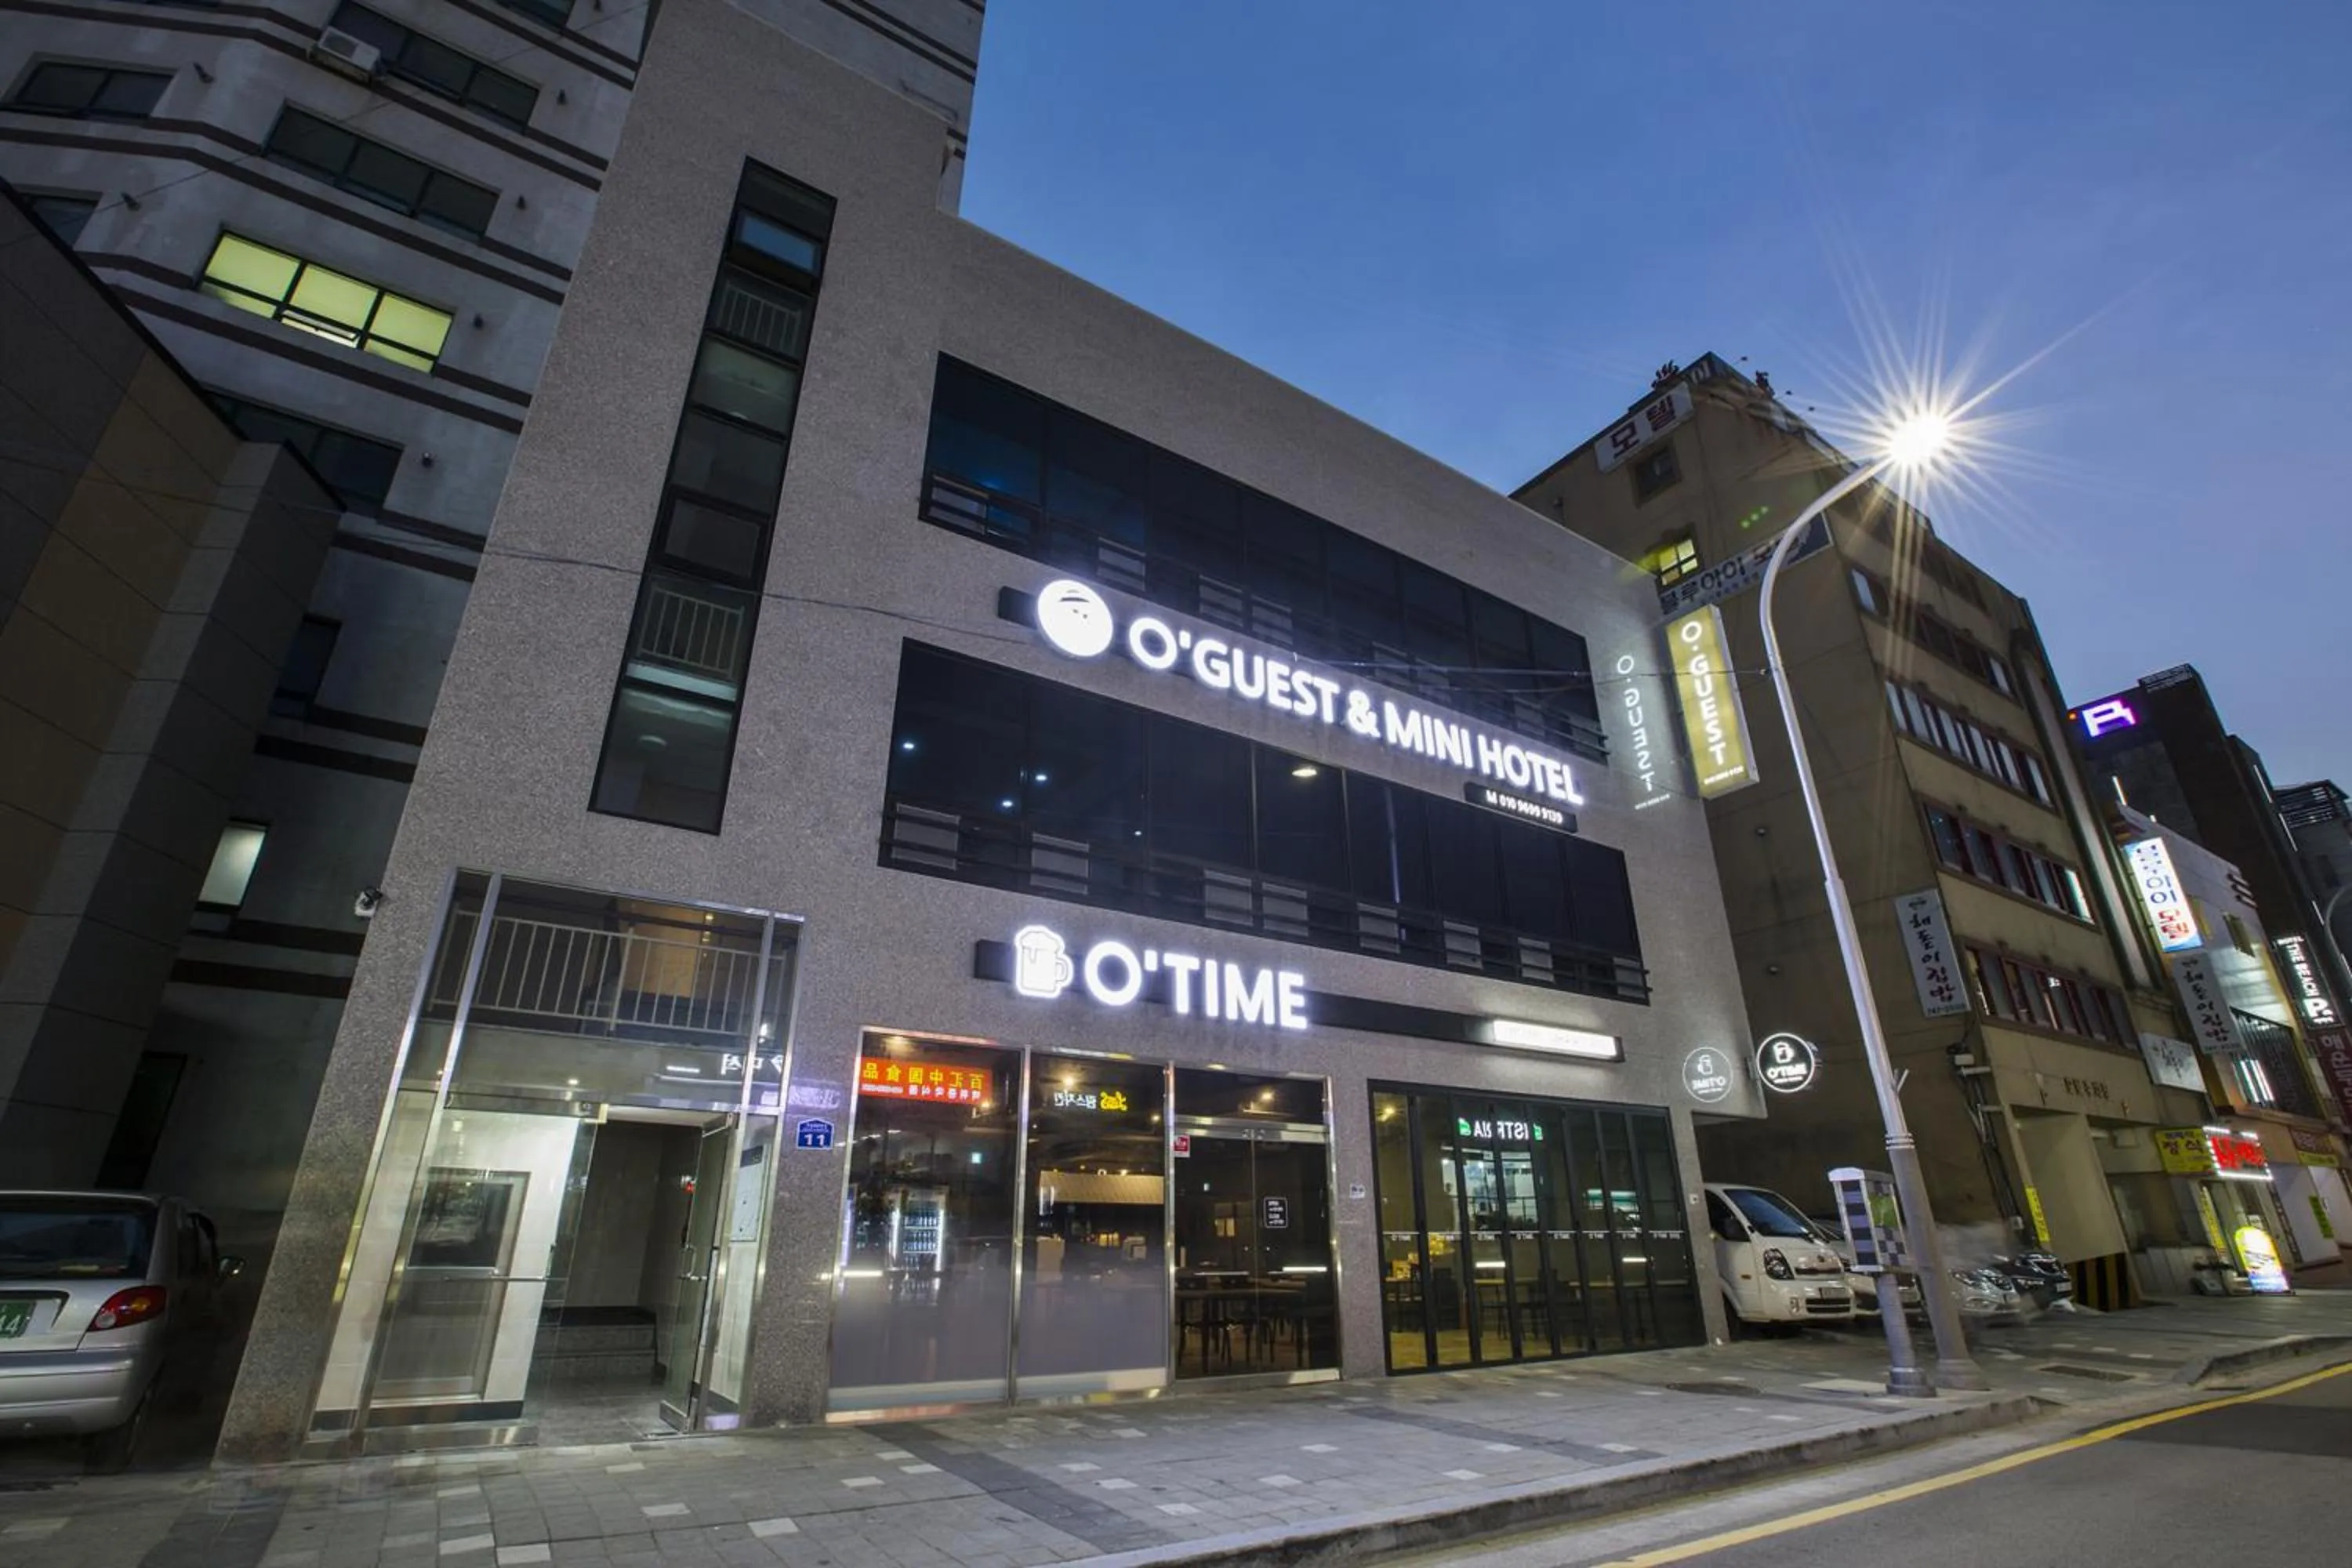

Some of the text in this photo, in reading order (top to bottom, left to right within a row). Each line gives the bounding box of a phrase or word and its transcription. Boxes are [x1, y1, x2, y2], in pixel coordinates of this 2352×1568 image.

[1610, 394, 1676, 459] 모텔
[1128, 616, 1584, 805] O'GUEST & MINI HOTEL
[1084, 941, 1308, 1030] O'TIME
[804, 1134, 826, 1145] 11
